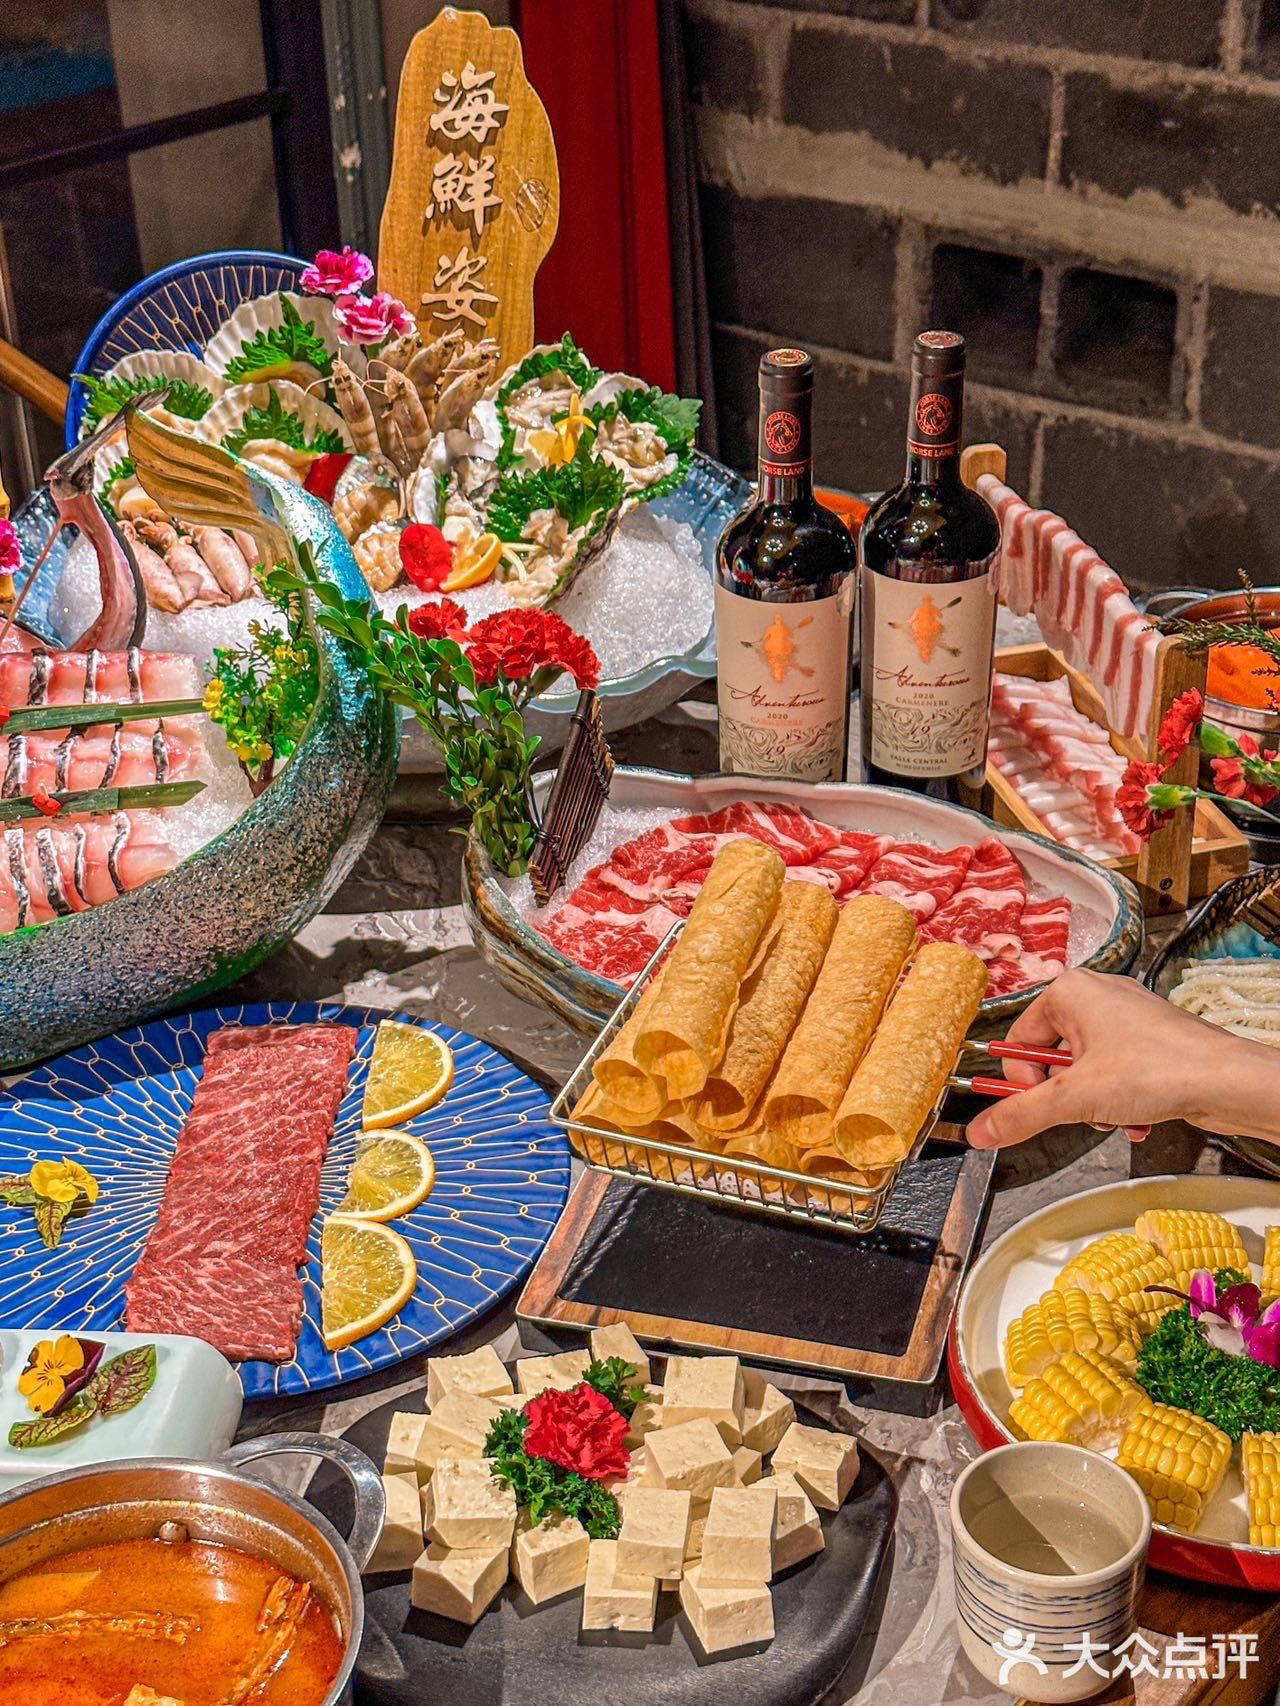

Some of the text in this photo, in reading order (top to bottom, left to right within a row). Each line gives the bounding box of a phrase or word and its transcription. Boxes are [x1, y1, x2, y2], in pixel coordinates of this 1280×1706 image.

[421, 60, 509, 327] 海鮮姿
[783, 466, 804, 476] LAND
[913, 692, 935, 700] 2020
